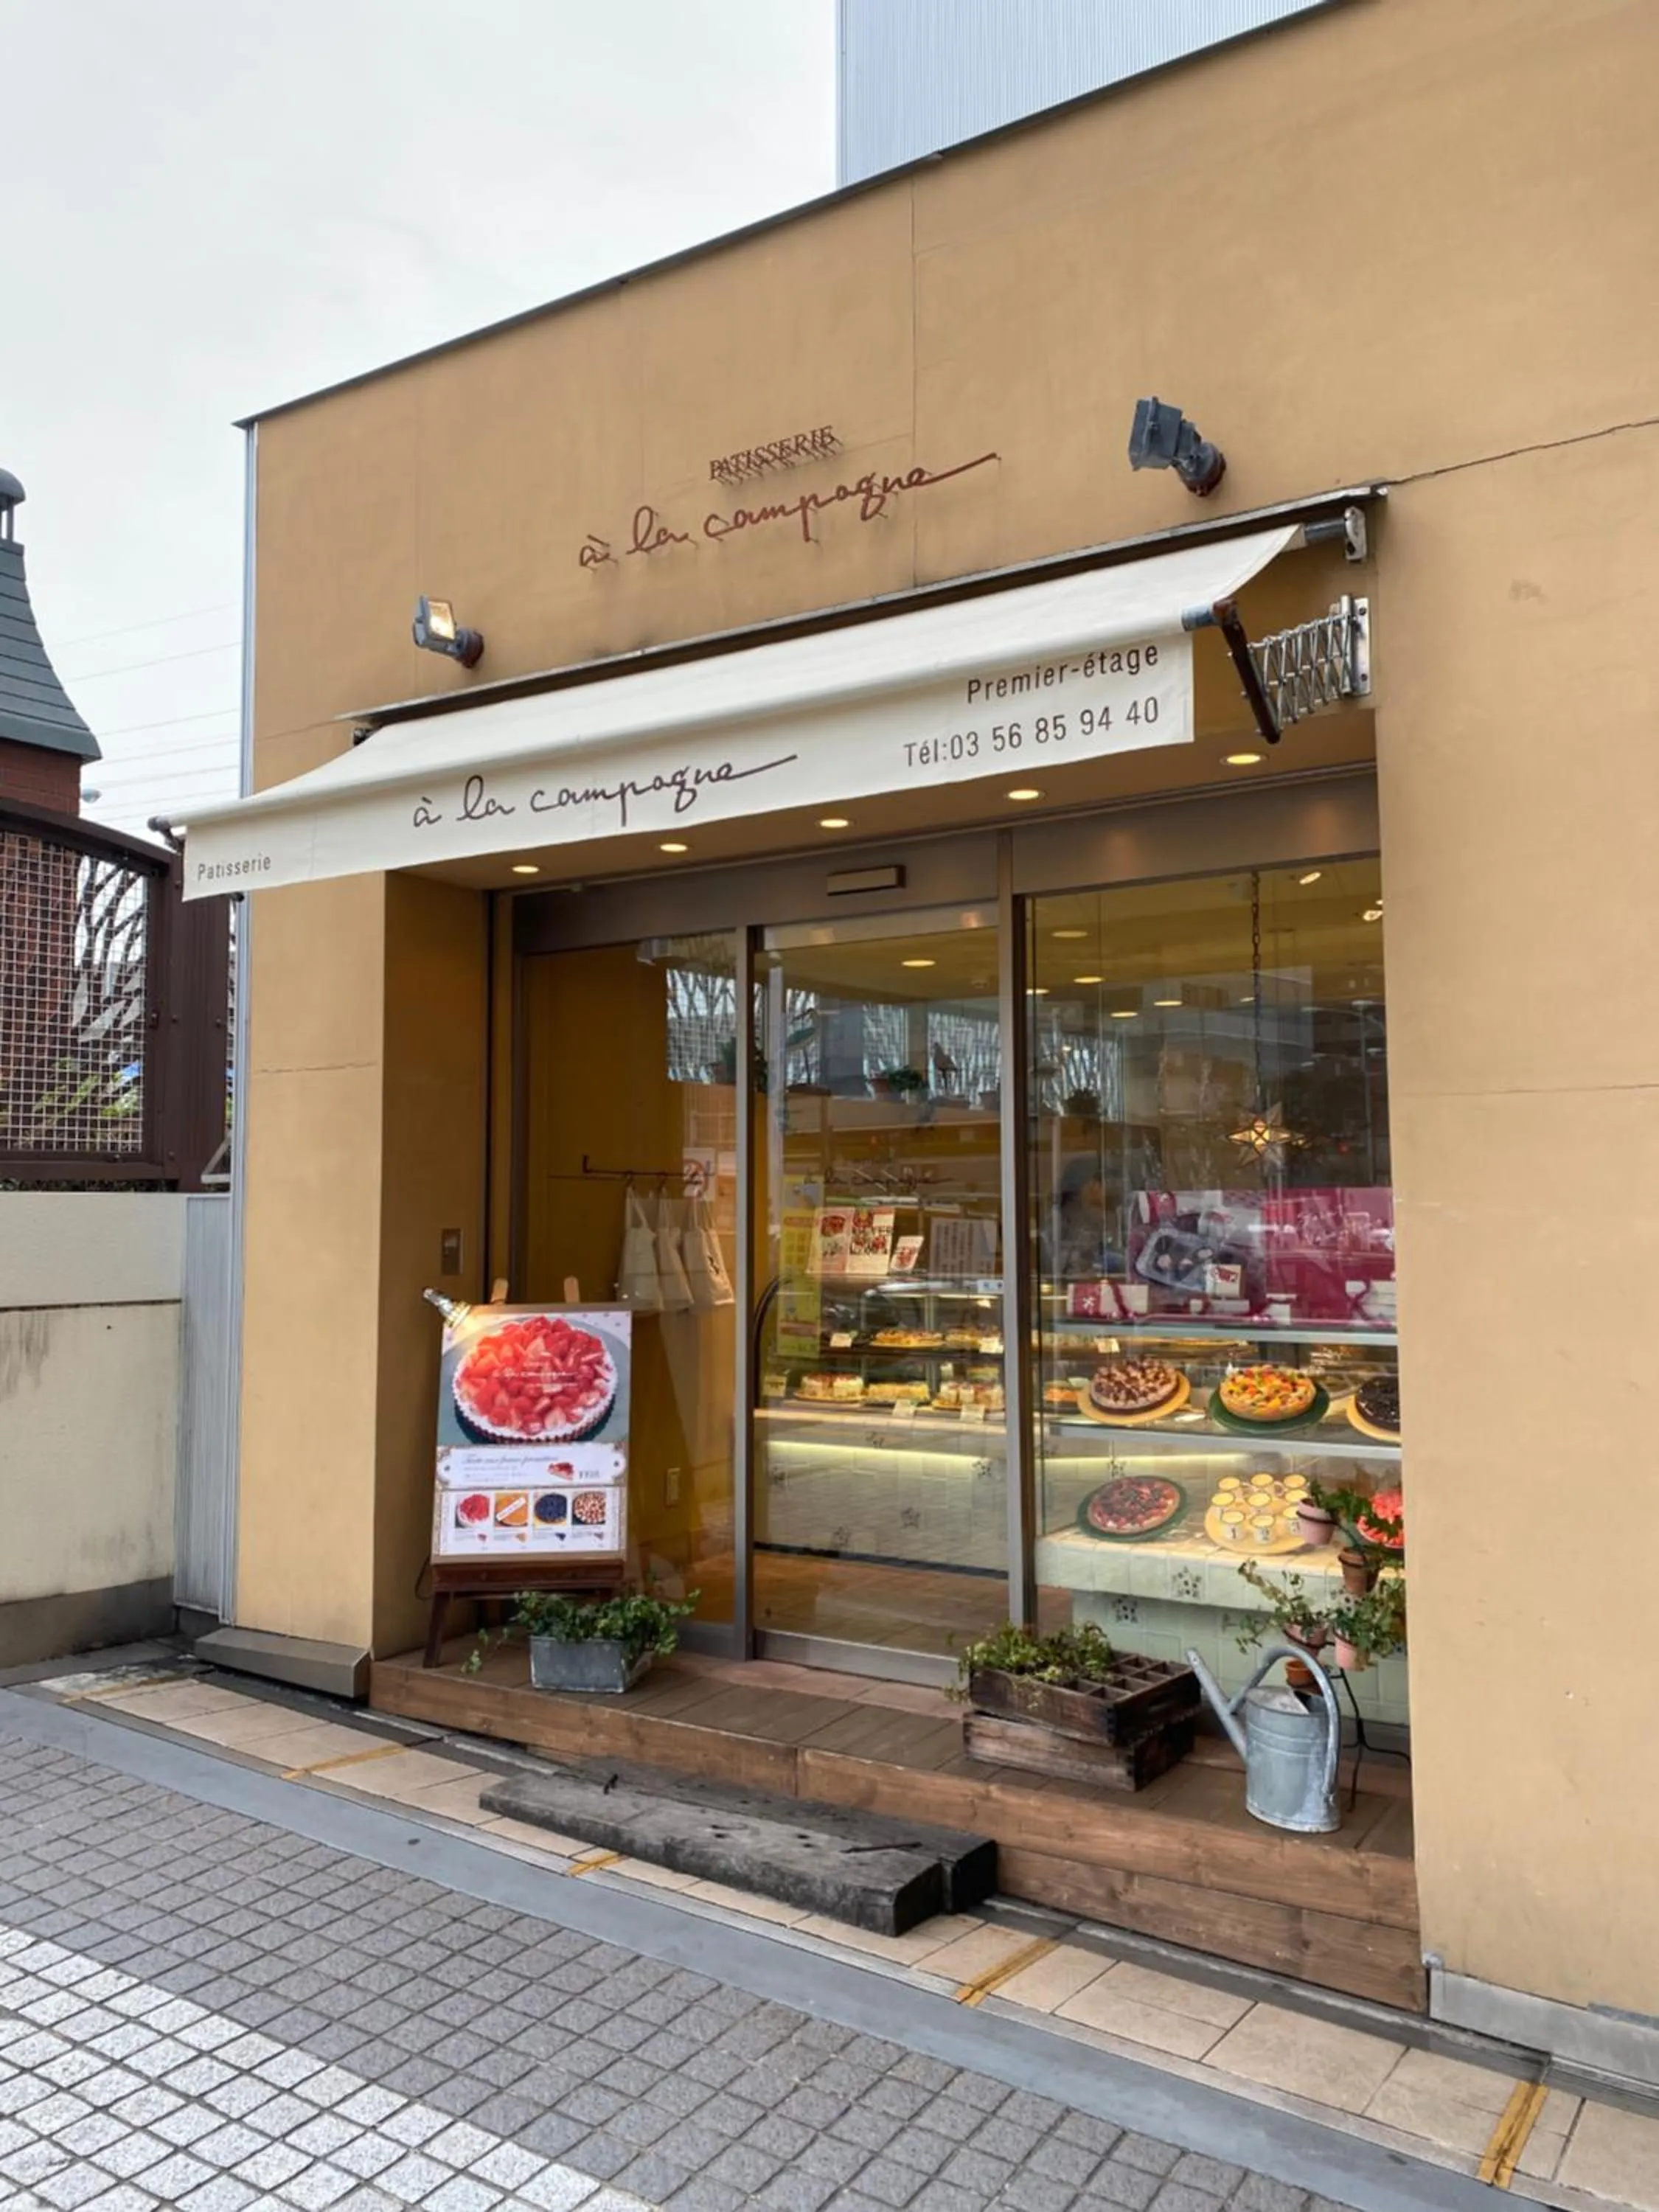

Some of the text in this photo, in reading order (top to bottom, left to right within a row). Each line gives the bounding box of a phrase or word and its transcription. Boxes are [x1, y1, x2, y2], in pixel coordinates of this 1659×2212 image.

[709, 425, 838, 482] PATISSERIE
[580, 452, 997, 566] à la campagne
[967, 644, 1159, 703] Premier-étage
[992, 722, 1023, 752] 56
[1035, 714, 1067, 745] 85
[1080, 706, 1113, 736] 94
[1125, 696, 1160, 726] 40
[414, 754, 798, 827] à la campagne
[198, 851, 271, 881] Patisserie
